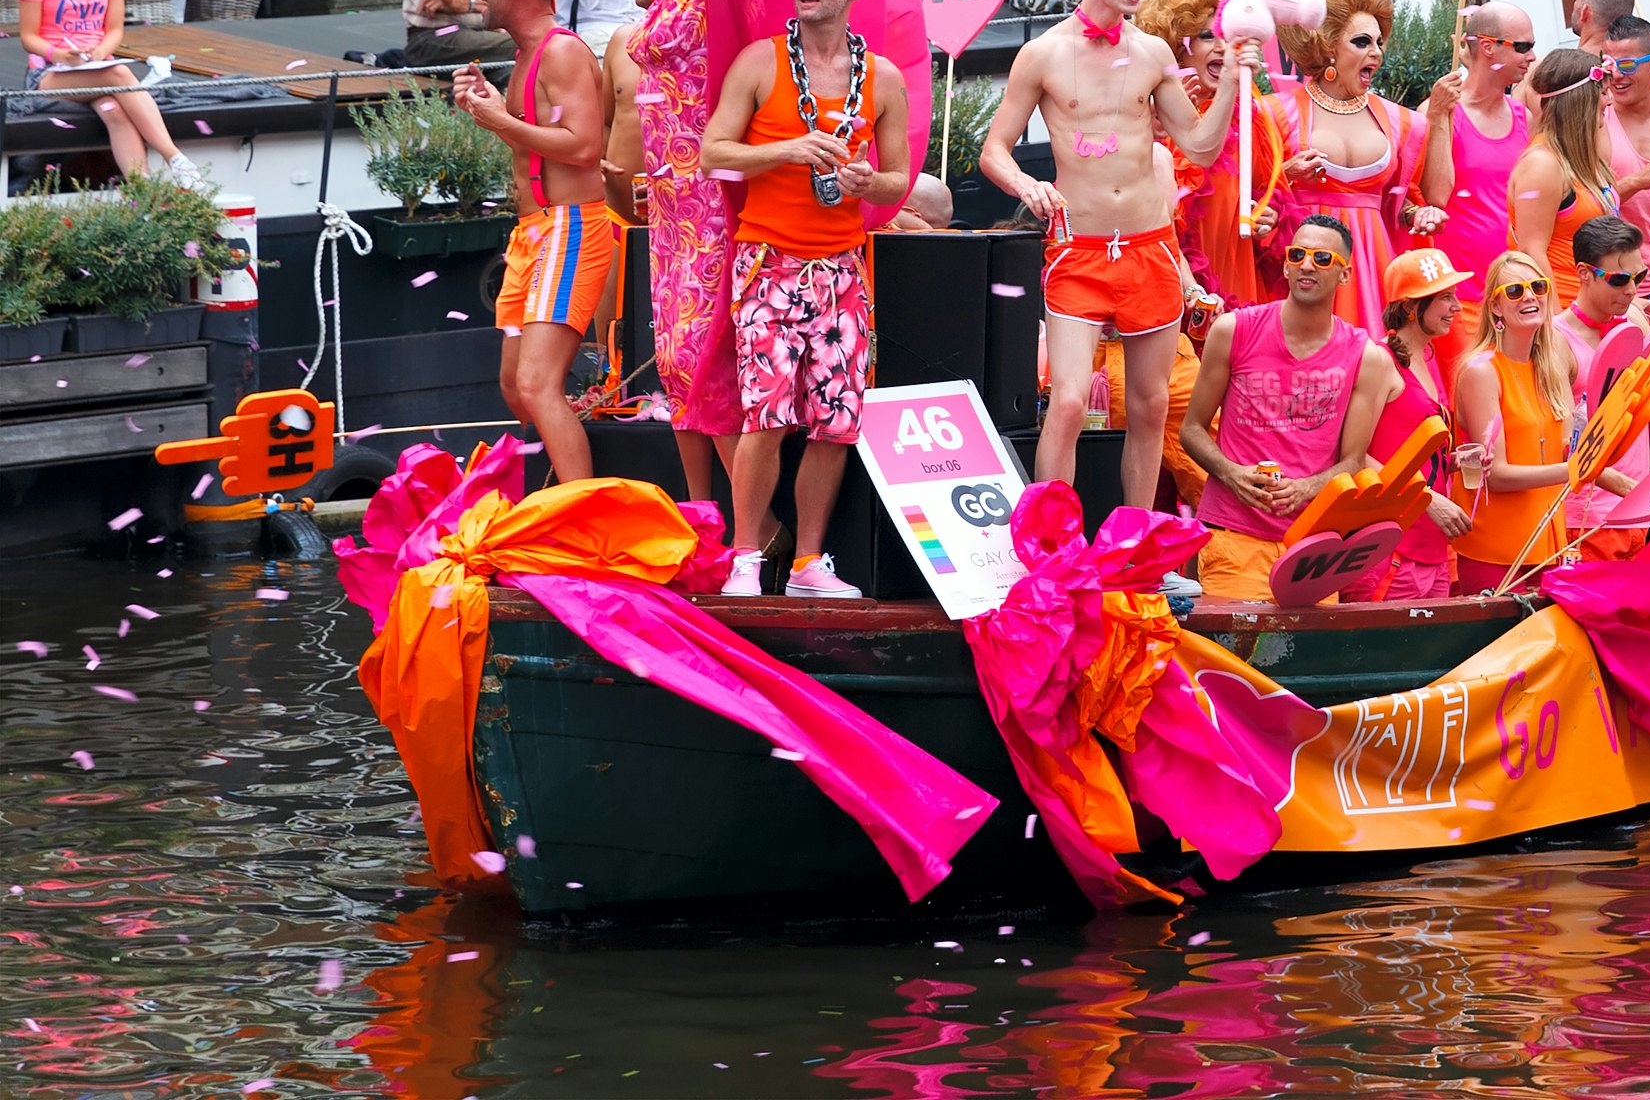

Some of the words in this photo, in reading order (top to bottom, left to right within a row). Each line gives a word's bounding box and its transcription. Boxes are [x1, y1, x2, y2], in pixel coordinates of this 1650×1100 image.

[1419, 253, 1455, 282] #1
[268, 408, 316, 478] H8
[1577, 415, 1605, 478] H8
[921, 461, 946, 474] box
[945, 459, 962, 472] 06
[959, 490, 1005, 519] GC
[970, 550, 1004, 568] GAY
[1291, 543, 1380, 583] WE
[1495, 668, 1560, 781] Go
